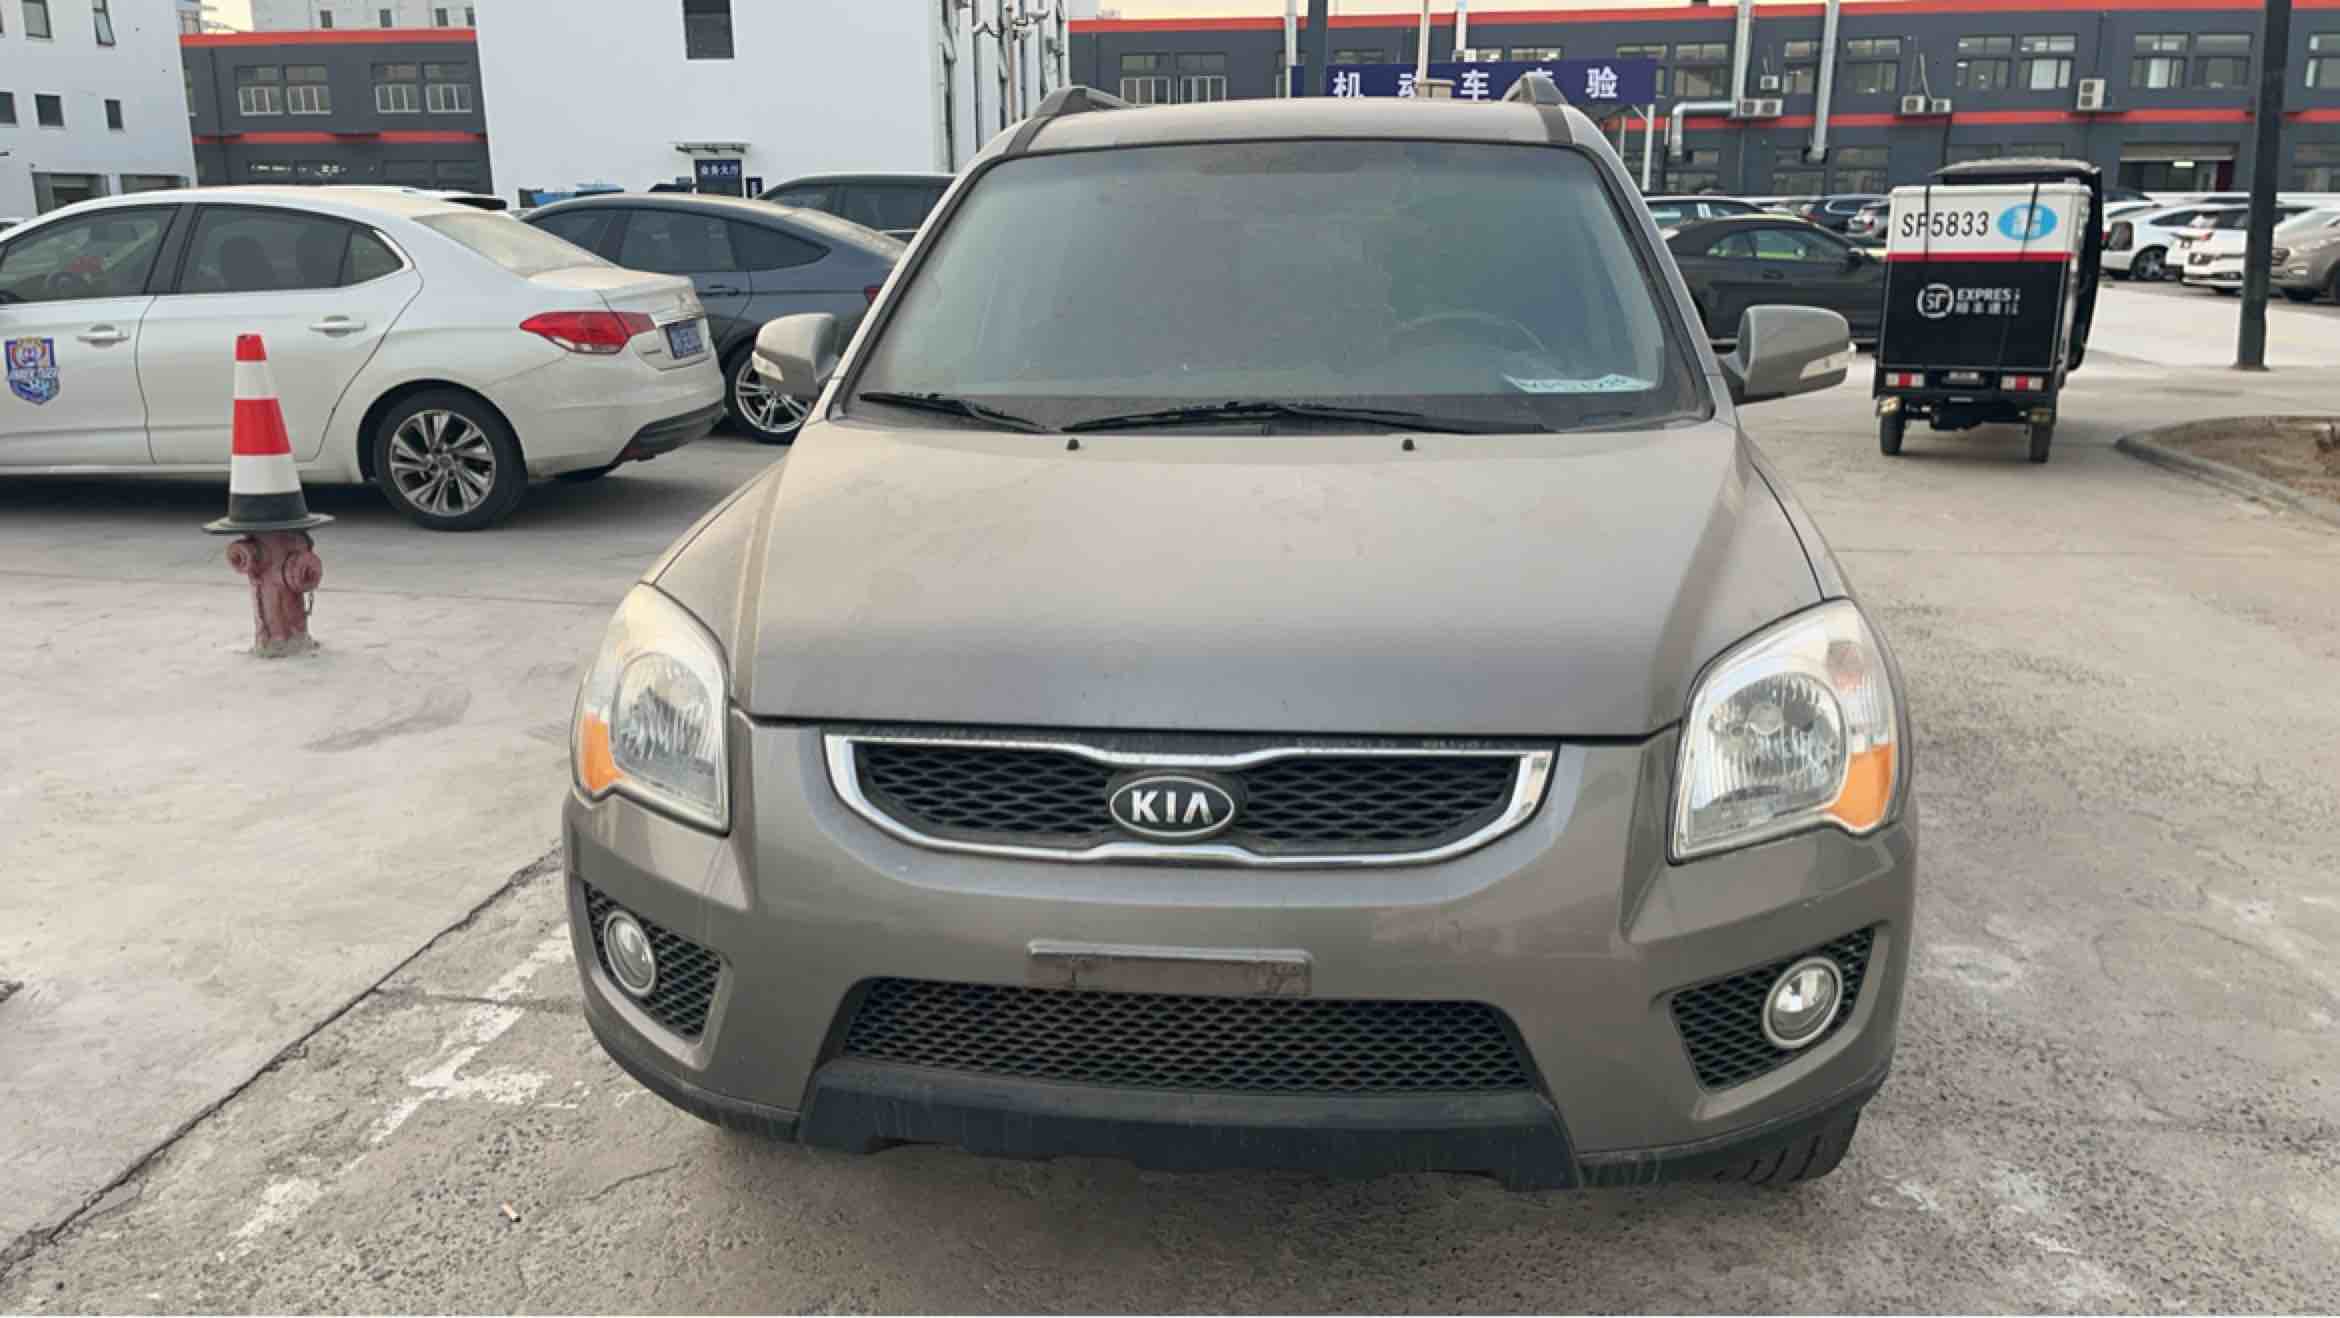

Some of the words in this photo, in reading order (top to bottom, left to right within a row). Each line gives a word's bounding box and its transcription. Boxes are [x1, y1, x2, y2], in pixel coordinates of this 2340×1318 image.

[1333, 66, 1618, 99] 机动车验
[1131, 790, 1213, 824] KIA
